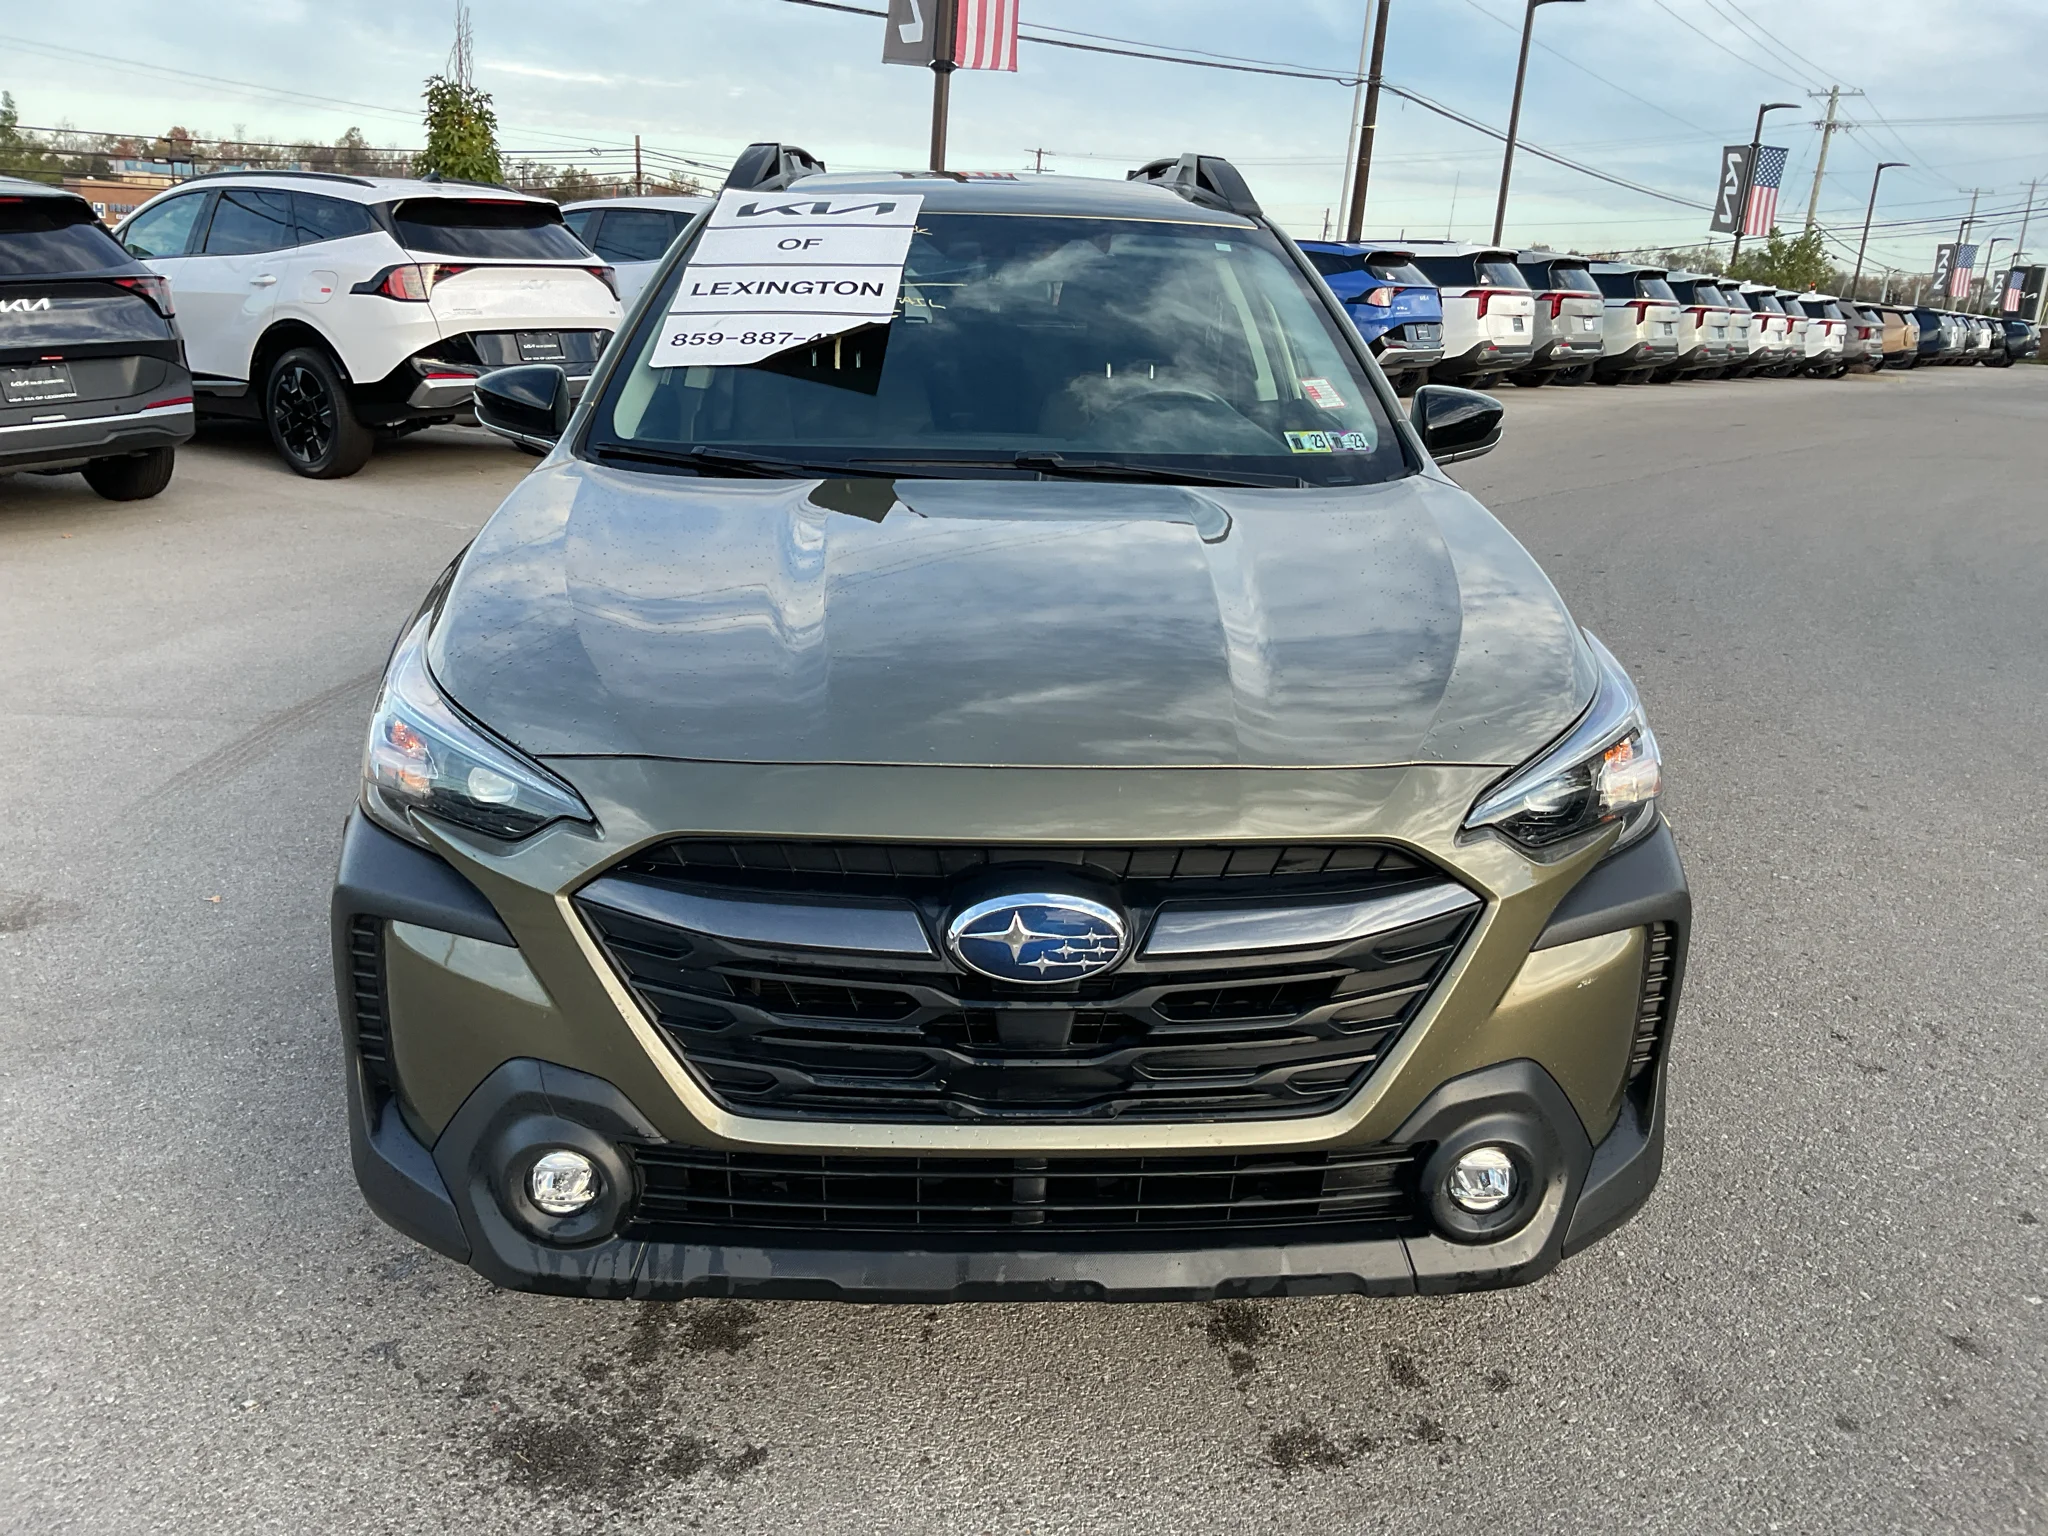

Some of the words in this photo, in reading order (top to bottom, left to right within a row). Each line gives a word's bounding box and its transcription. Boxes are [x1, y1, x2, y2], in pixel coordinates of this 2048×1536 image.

[736, 201, 897, 218] KIA
[777, 238, 823, 251] OF
[690, 281, 884, 297] LEXINGTON
[1311, 434, 1326, 449] 23
[1350, 433, 1365, 448] 23
